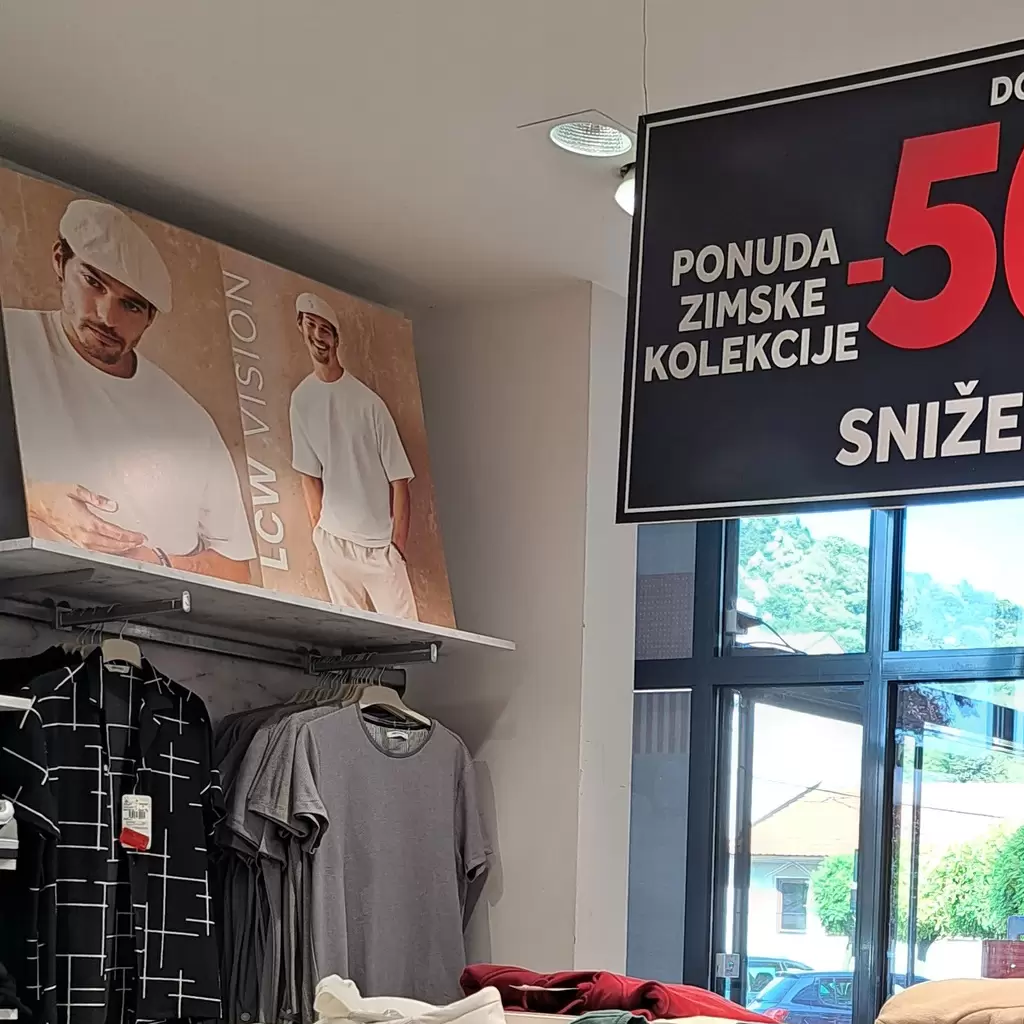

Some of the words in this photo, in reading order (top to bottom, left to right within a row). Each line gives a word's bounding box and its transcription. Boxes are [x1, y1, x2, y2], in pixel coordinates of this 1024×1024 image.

[671, 228, 840, 286] PONUDA
[678, 278, 827, 333] ZIMSKE
[223, 270, 270, 437] VISION
[644, 322, 860, 382] KOLEKCIJE
[245, 455, 289, 571] LCW
